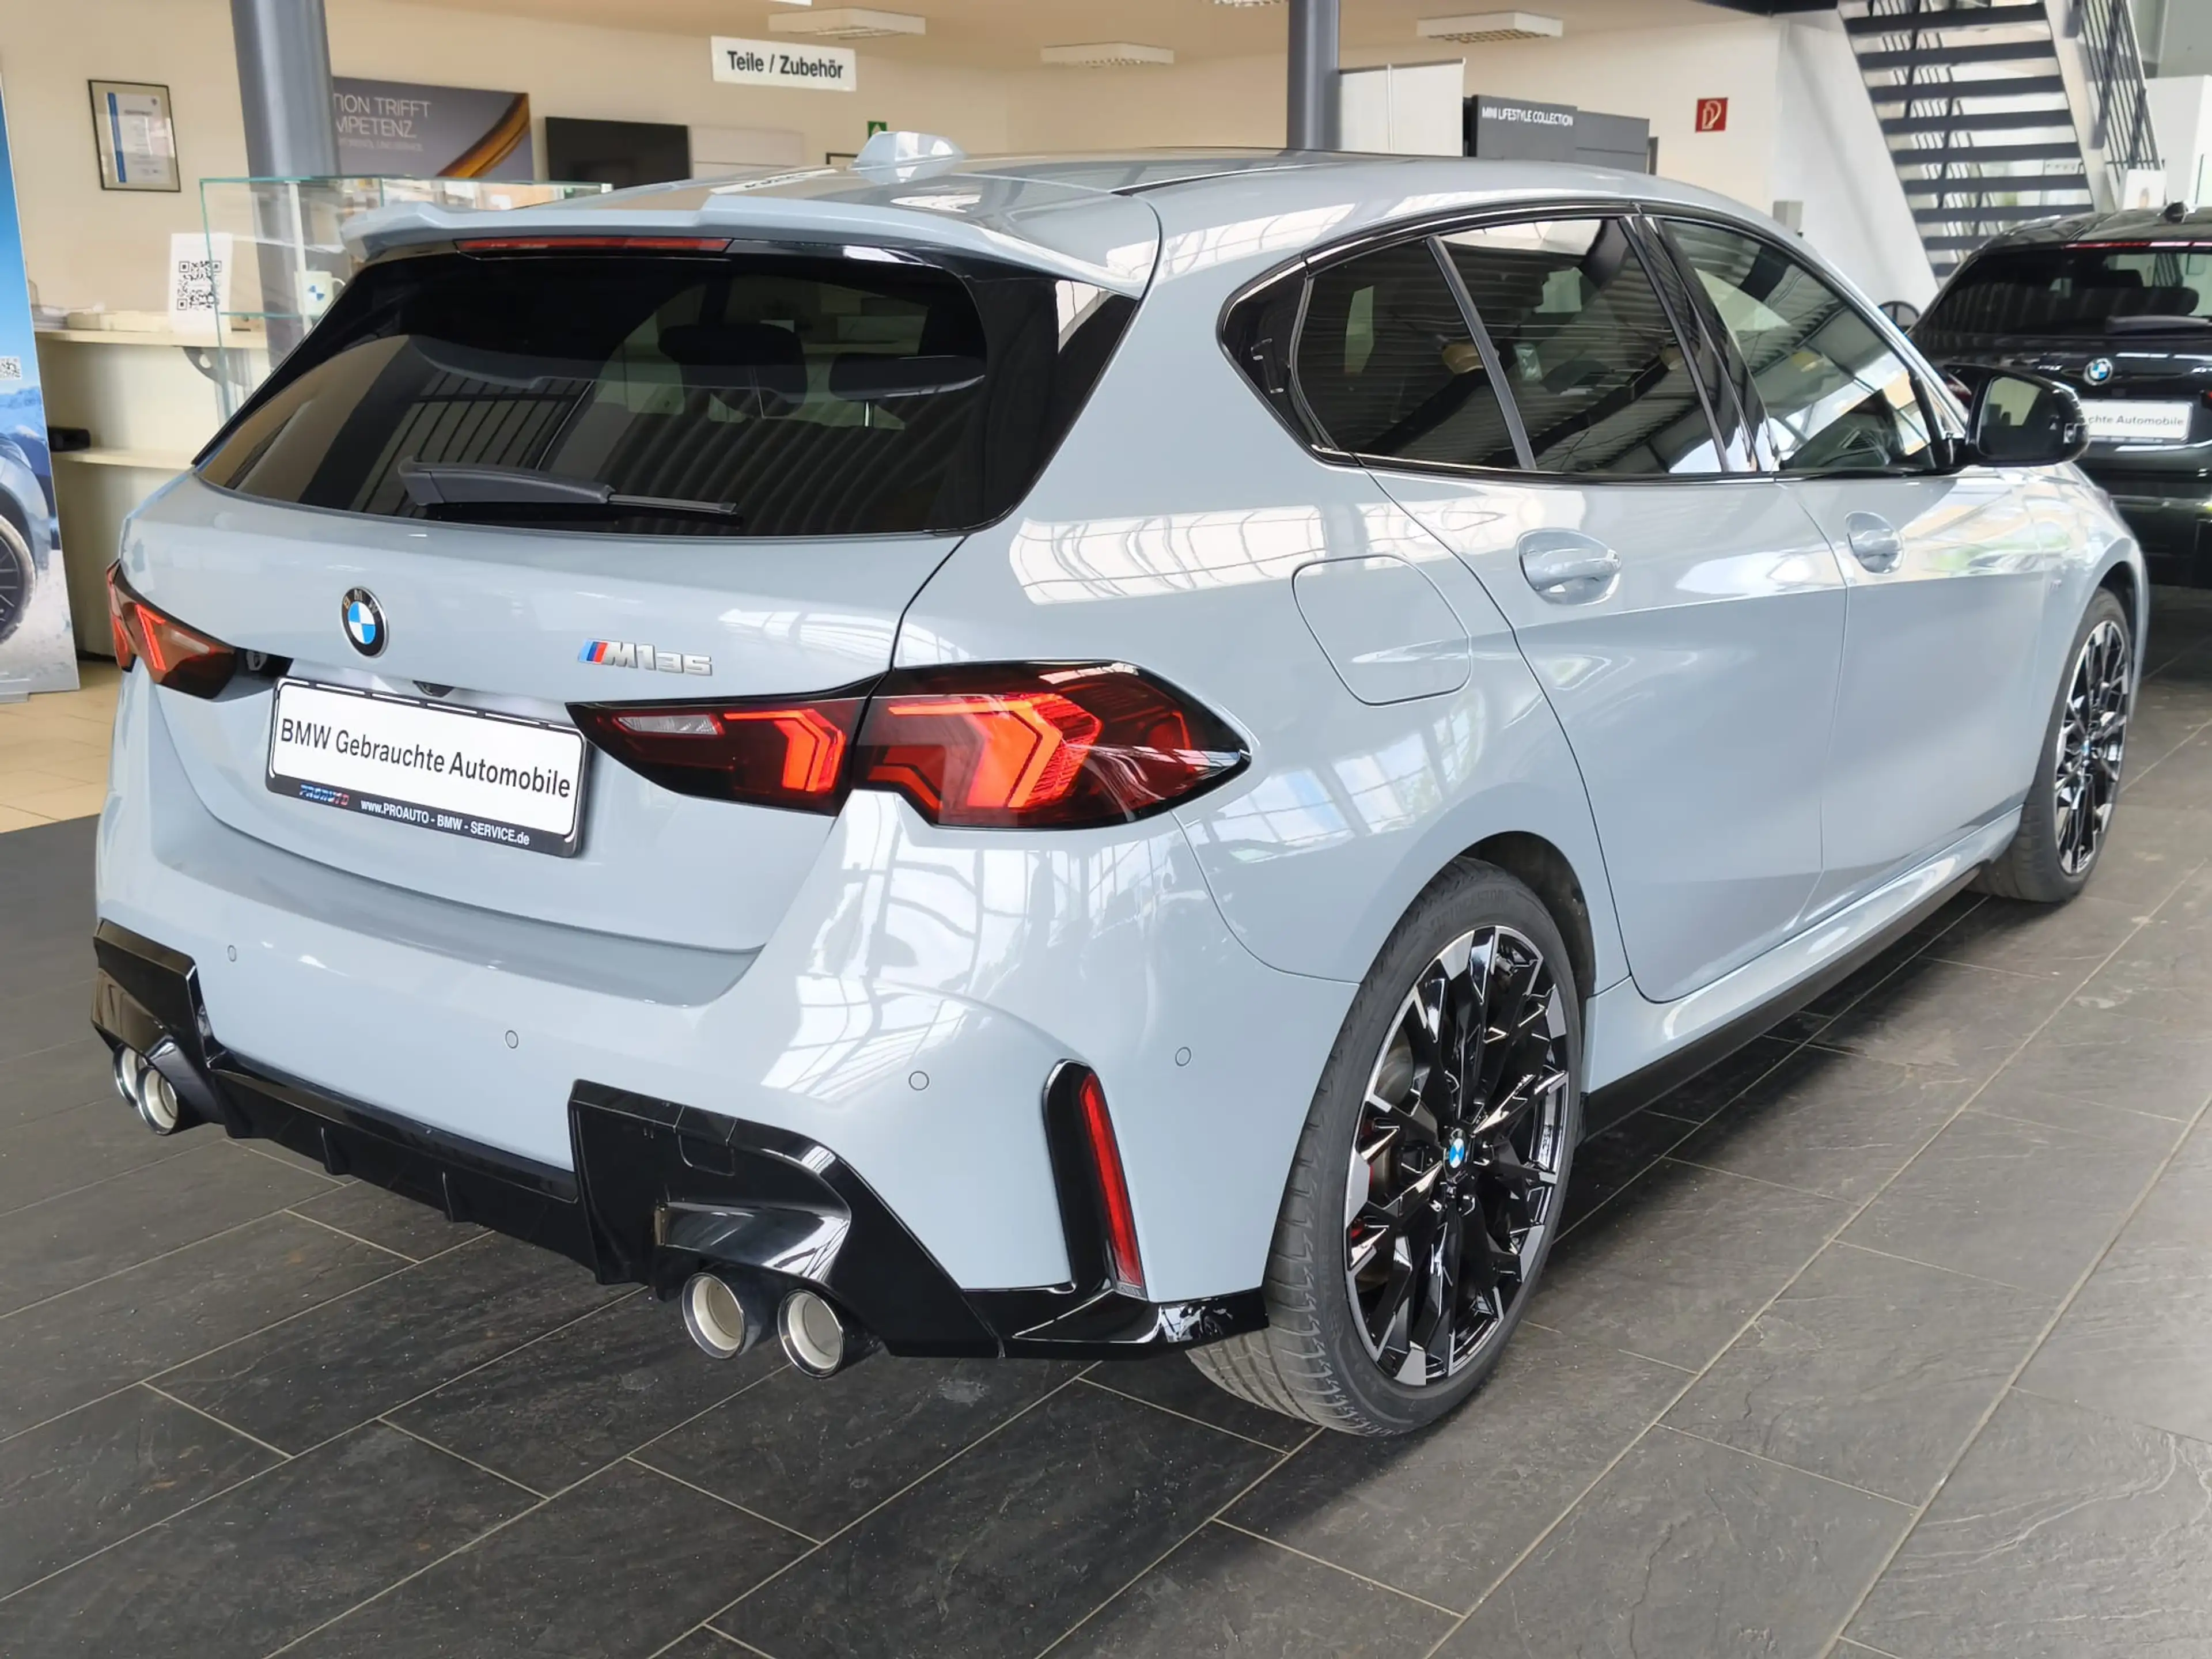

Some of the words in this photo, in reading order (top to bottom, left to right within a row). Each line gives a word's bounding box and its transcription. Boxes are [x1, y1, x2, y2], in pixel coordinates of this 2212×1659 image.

[727, 51, 764, 72] Teile
[769, 54, 775, 73] /
[779, 55, 843, 78] Zubehör
[373, 97, 431, 118] TRIFFT
[1498, 108, 1532, 122] LIFESTYLE
[1533, 111, 1573, 126] COLLECTION
[2116, 415, 2184, 426] Automobile
[601, 641, 713, 676] M135
[281, 718, 332, 750] BMW
[335, 729, 445, 773] Gebrauchte
[448, 751, 571, 798] Automobile
[361, 800, 429, 824] www.PROAUTO
[437, 813, 463, 831] BMW
[470, 821, 530, 846] SERVICE.de
